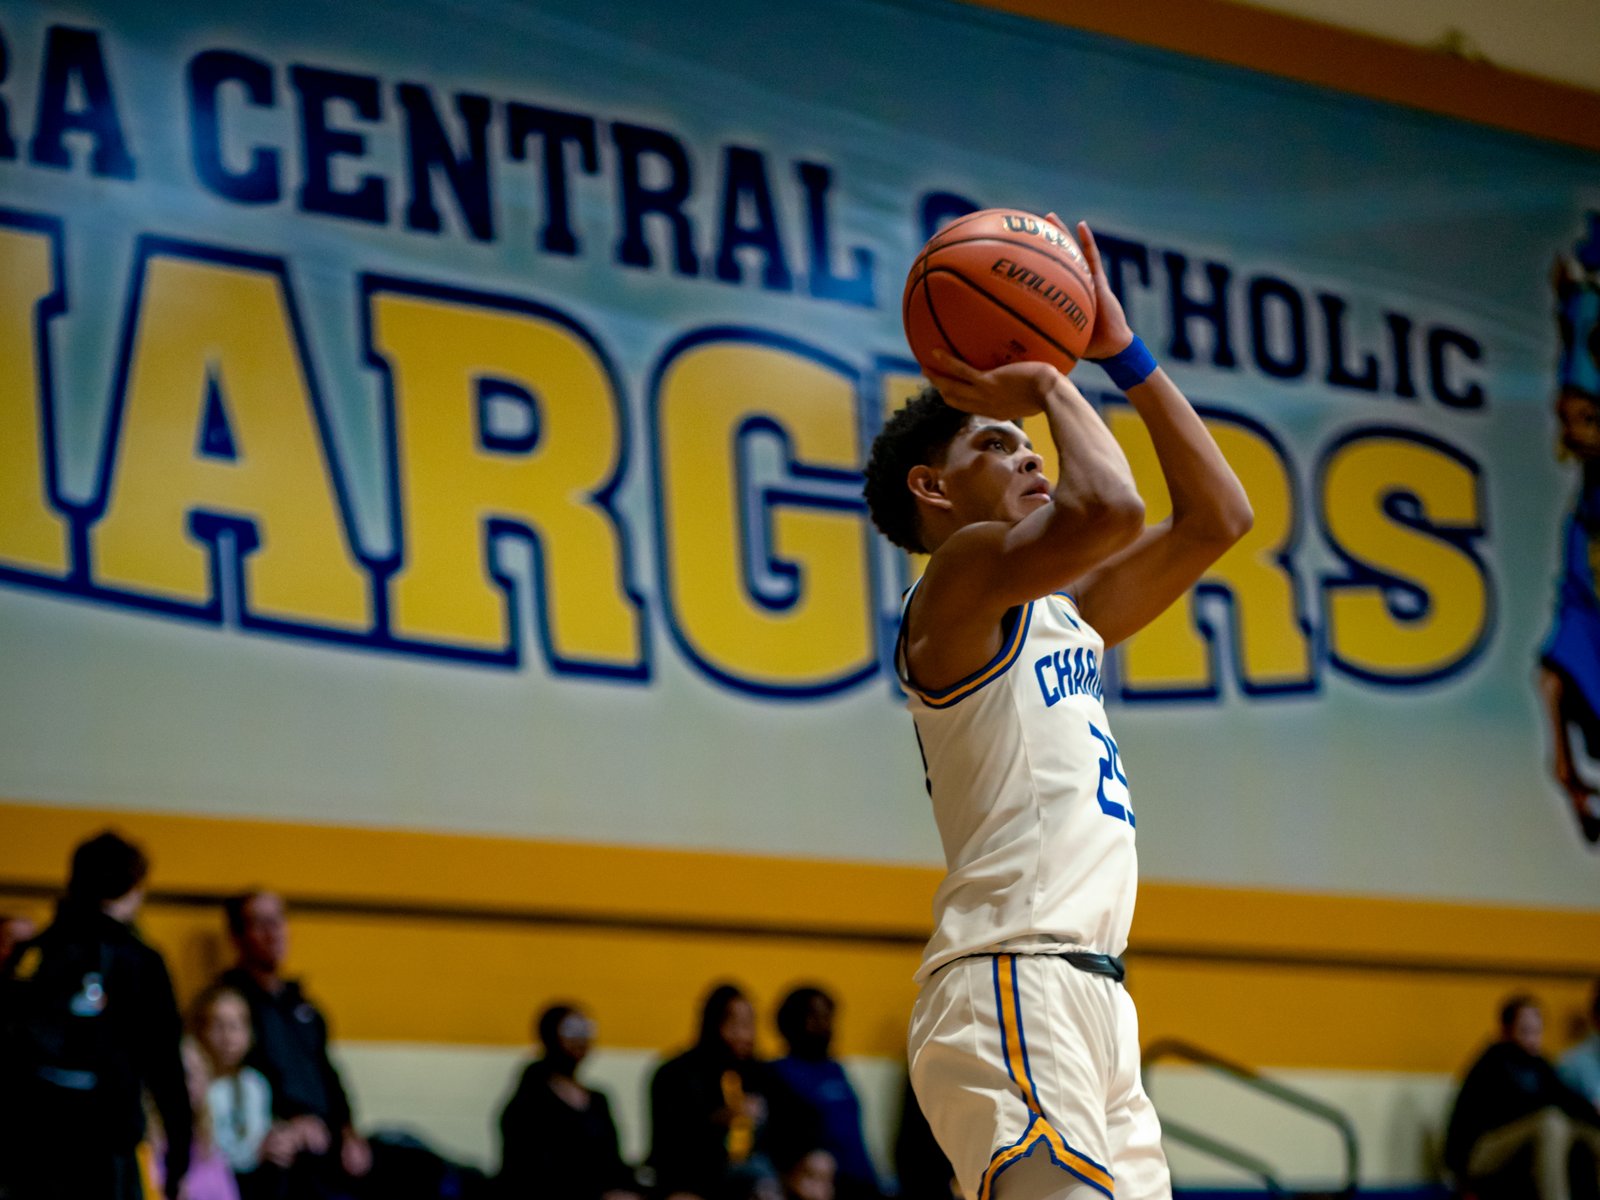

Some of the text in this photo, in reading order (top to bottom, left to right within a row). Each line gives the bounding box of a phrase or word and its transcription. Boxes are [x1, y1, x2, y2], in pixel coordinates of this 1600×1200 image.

[0, 24, 1487, 411] A CENTRAL THOLIC
[991, 257, 1089, 332] EVOLUTION
[0, 206, 1495, 706] ARGRS
